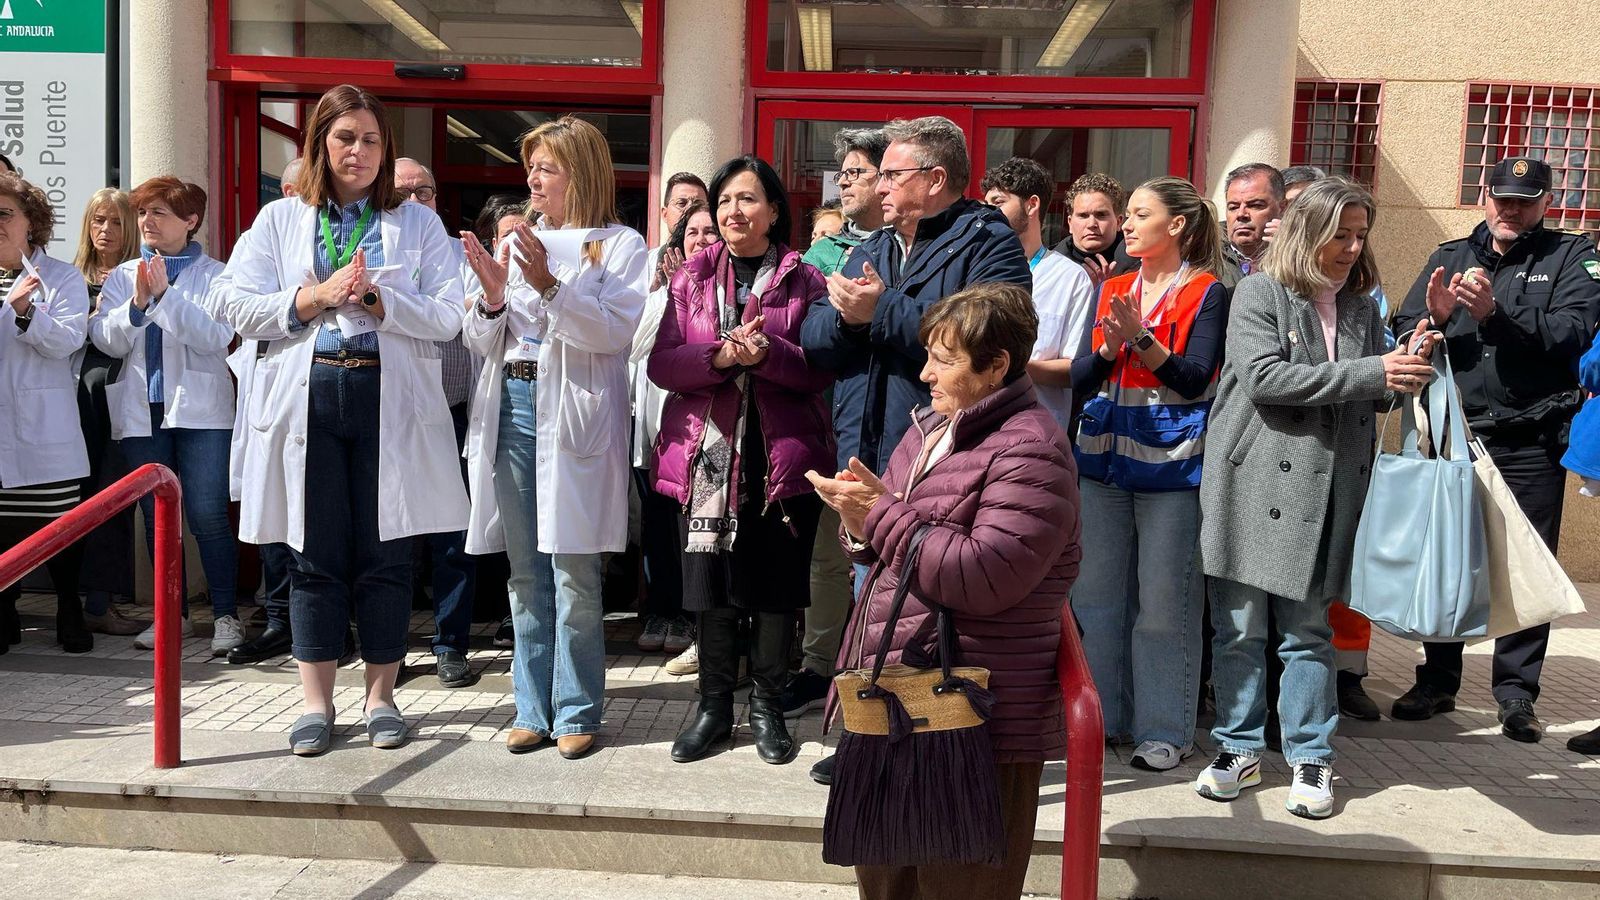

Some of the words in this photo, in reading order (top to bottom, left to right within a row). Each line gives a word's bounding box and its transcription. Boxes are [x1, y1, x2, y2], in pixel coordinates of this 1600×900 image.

[0, 80, 25, 157] Salud
[39, 80, 67, 165] Puente
[1515, 271, 1549, 283] POICIA
